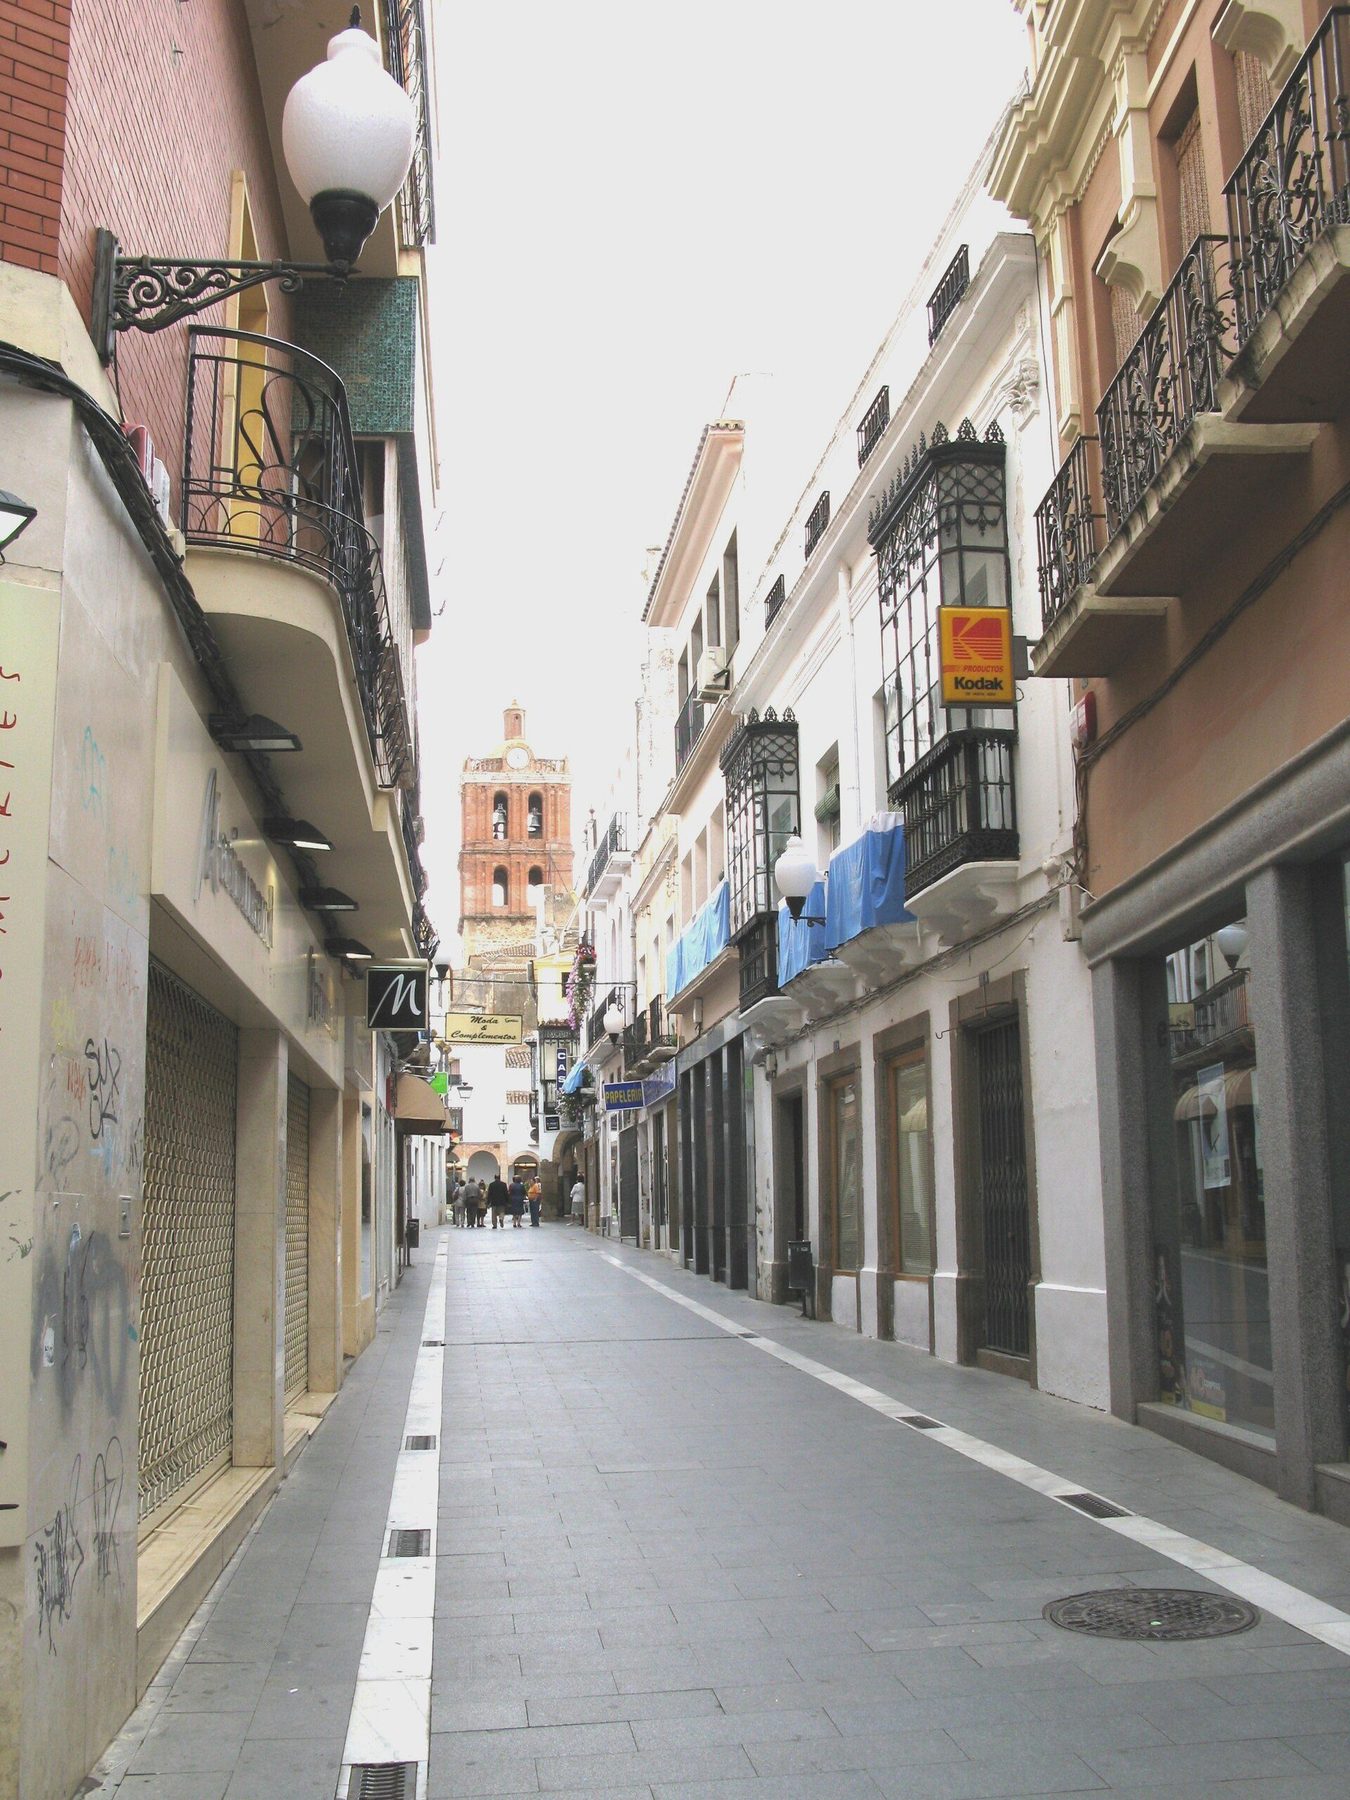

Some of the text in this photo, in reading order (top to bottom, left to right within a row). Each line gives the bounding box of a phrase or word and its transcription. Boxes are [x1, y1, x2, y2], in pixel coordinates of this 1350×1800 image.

[954, 676, 1004, 690] Kodak
[470, 1015, 499, 1024] Moda
[451, 1030, 517, 1040] Complementos
